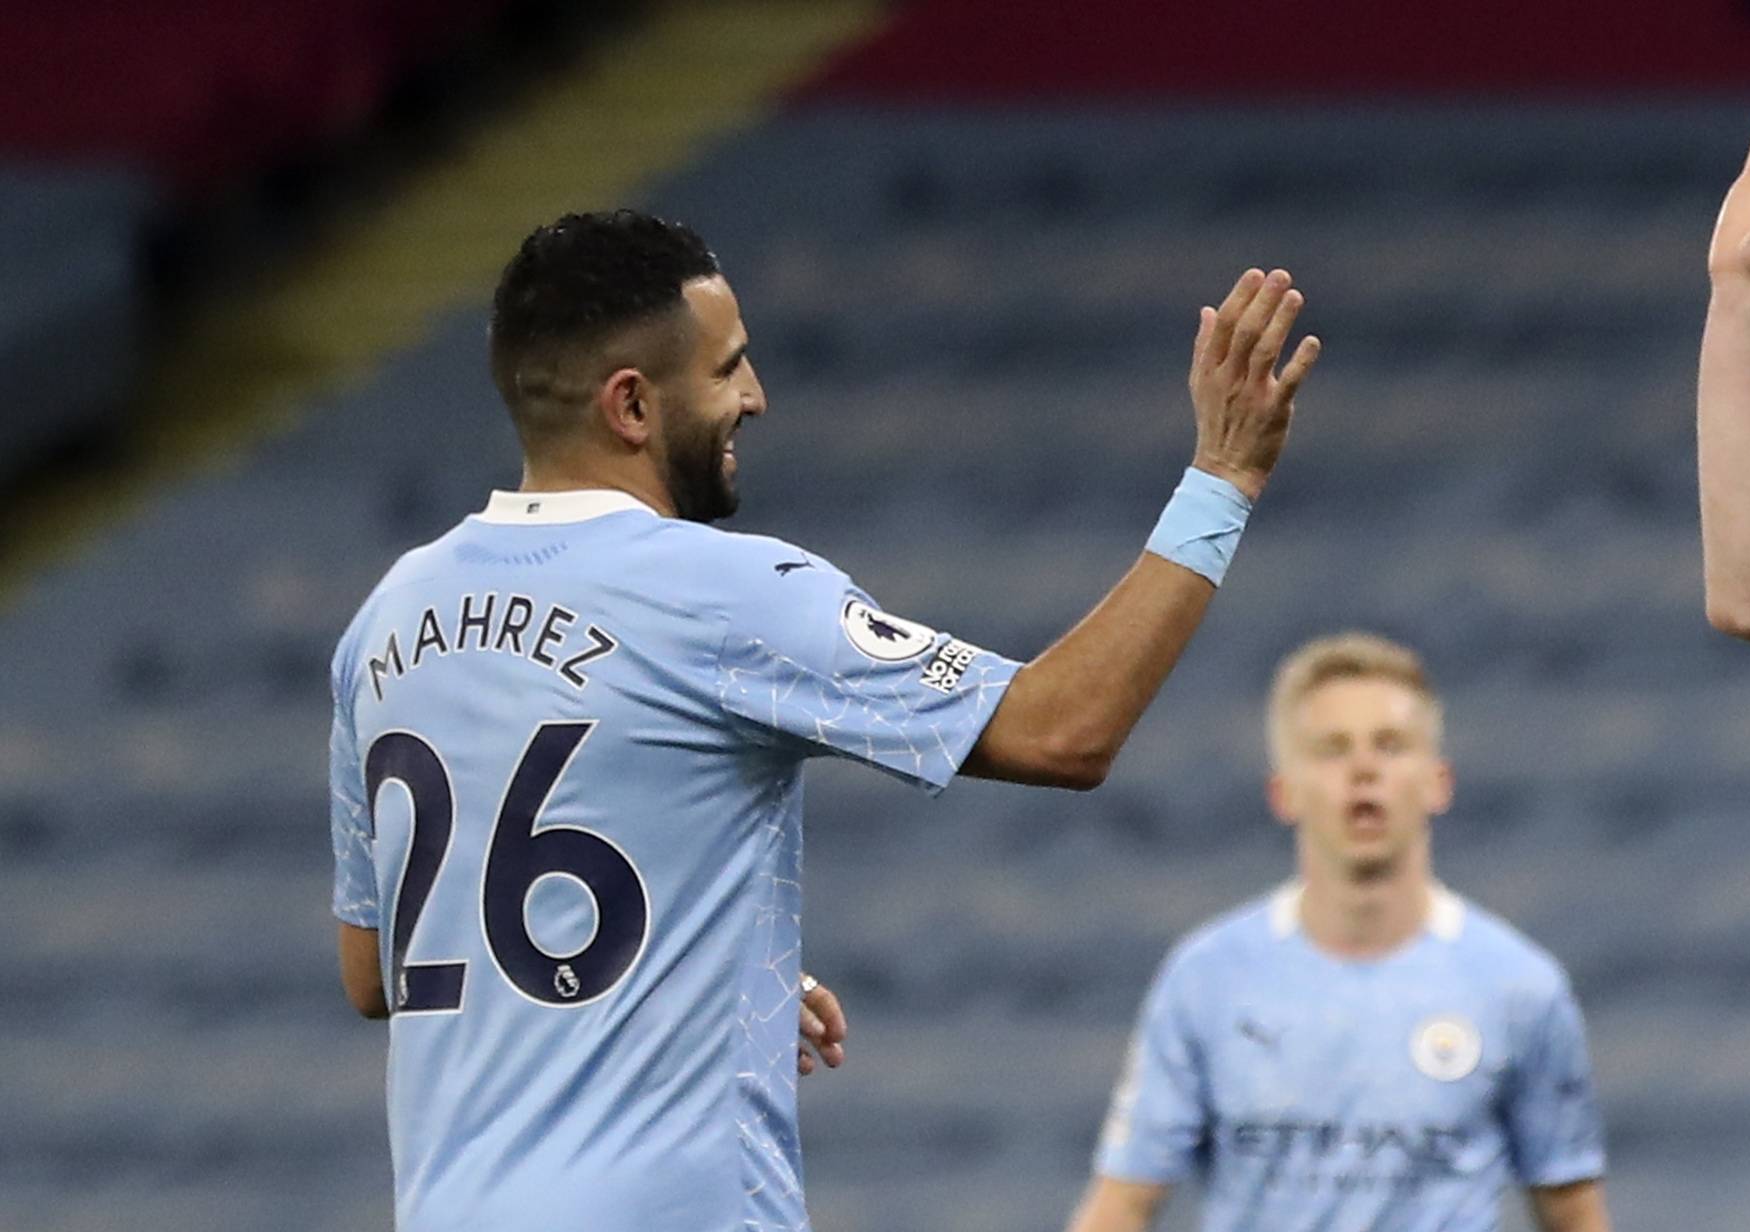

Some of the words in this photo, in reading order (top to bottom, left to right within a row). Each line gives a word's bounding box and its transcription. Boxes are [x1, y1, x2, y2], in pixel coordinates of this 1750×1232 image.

[367, 593, 618, 701] MAHREZ
[919, 660, 947, 689] No
[365, 719, 650, 1017] 26
